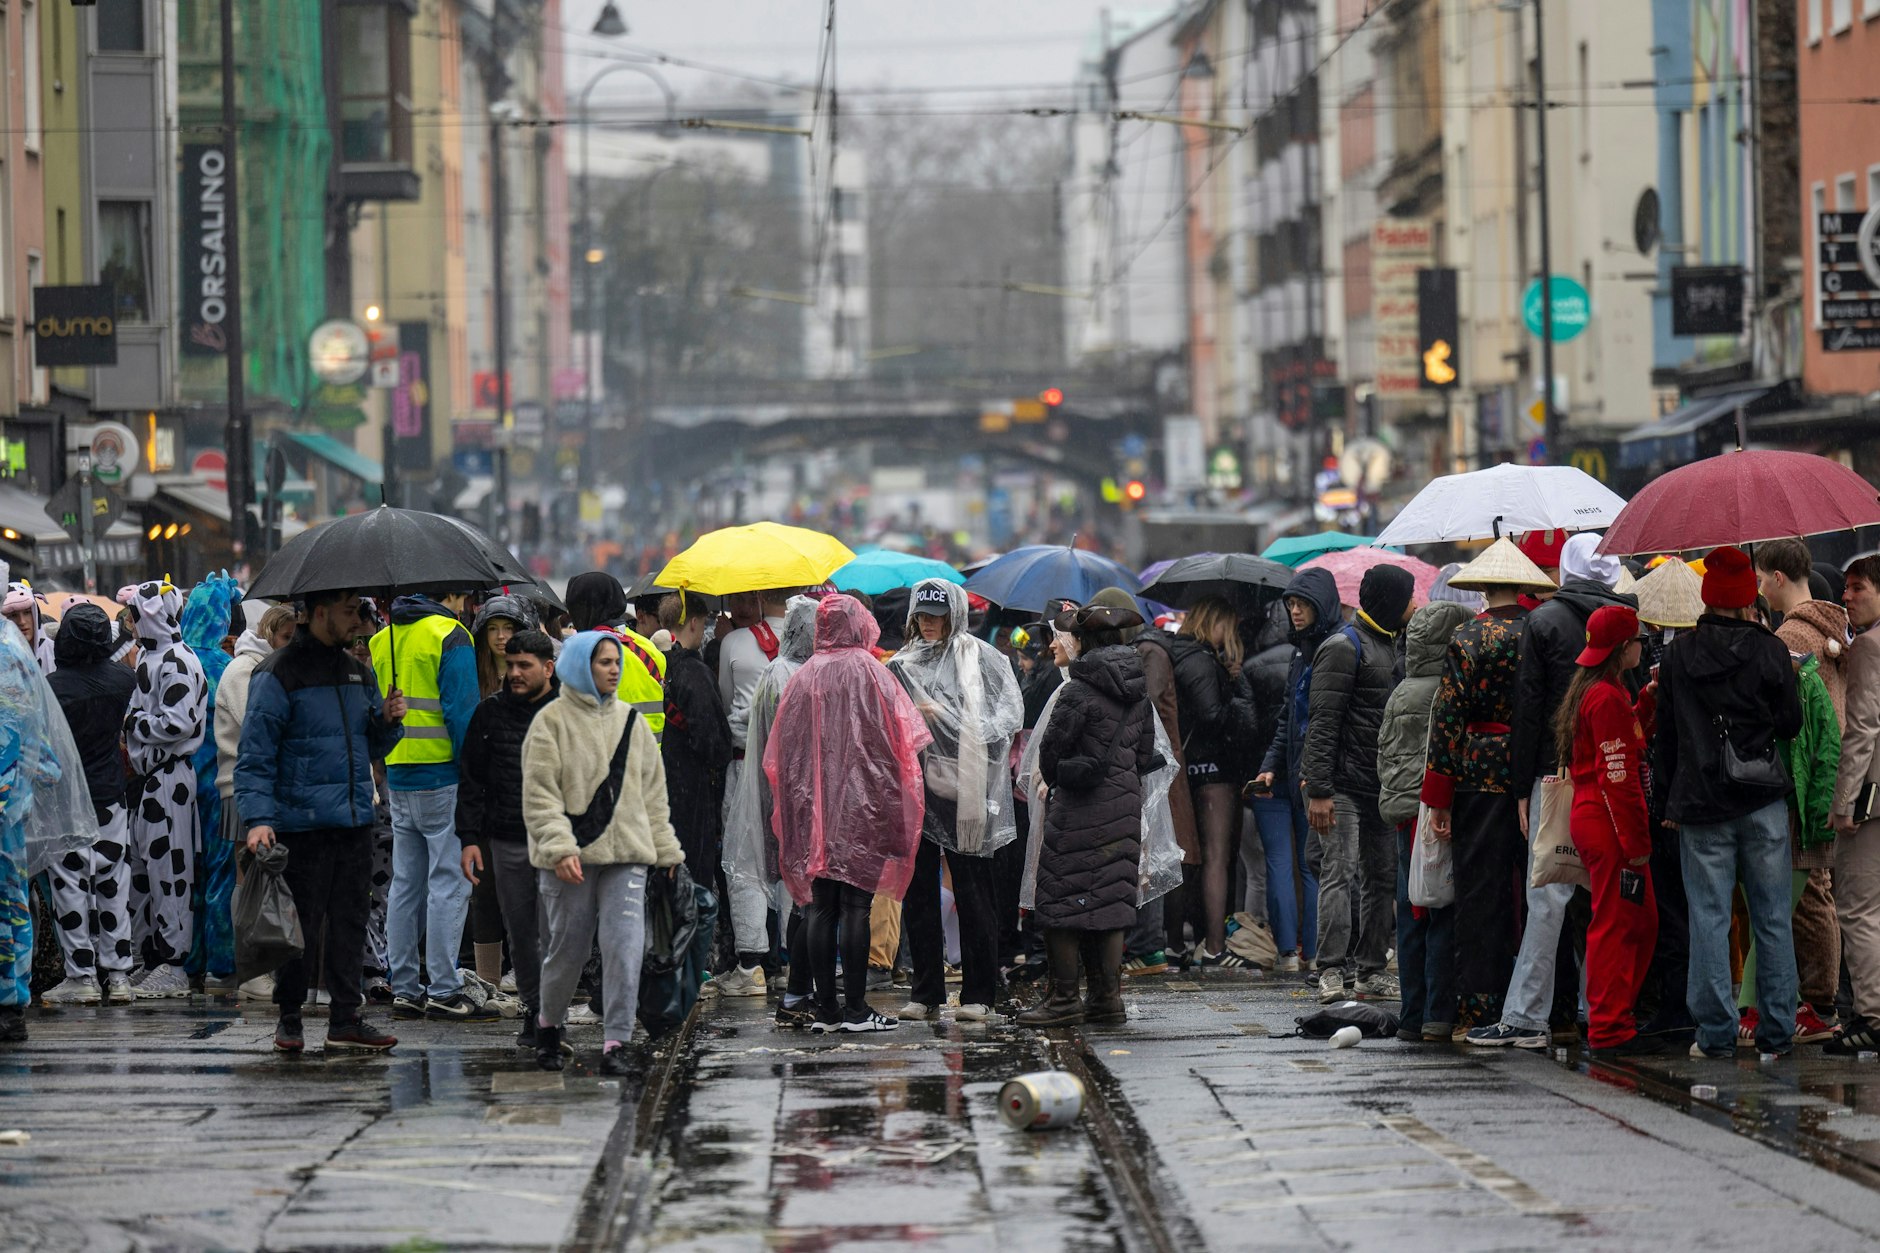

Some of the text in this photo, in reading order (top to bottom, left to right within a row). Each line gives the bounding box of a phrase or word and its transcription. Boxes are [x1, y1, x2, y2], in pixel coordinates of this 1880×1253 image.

[1822, 214, 1842, 234] M
[1824, 243, 1840, 263] T
[1824, 272, 1842, 293] C
[37, 314, 113, 337] duma
[1573, 506, 1602, 515] INESIS
[916, 589, 947, 603] POLICE
